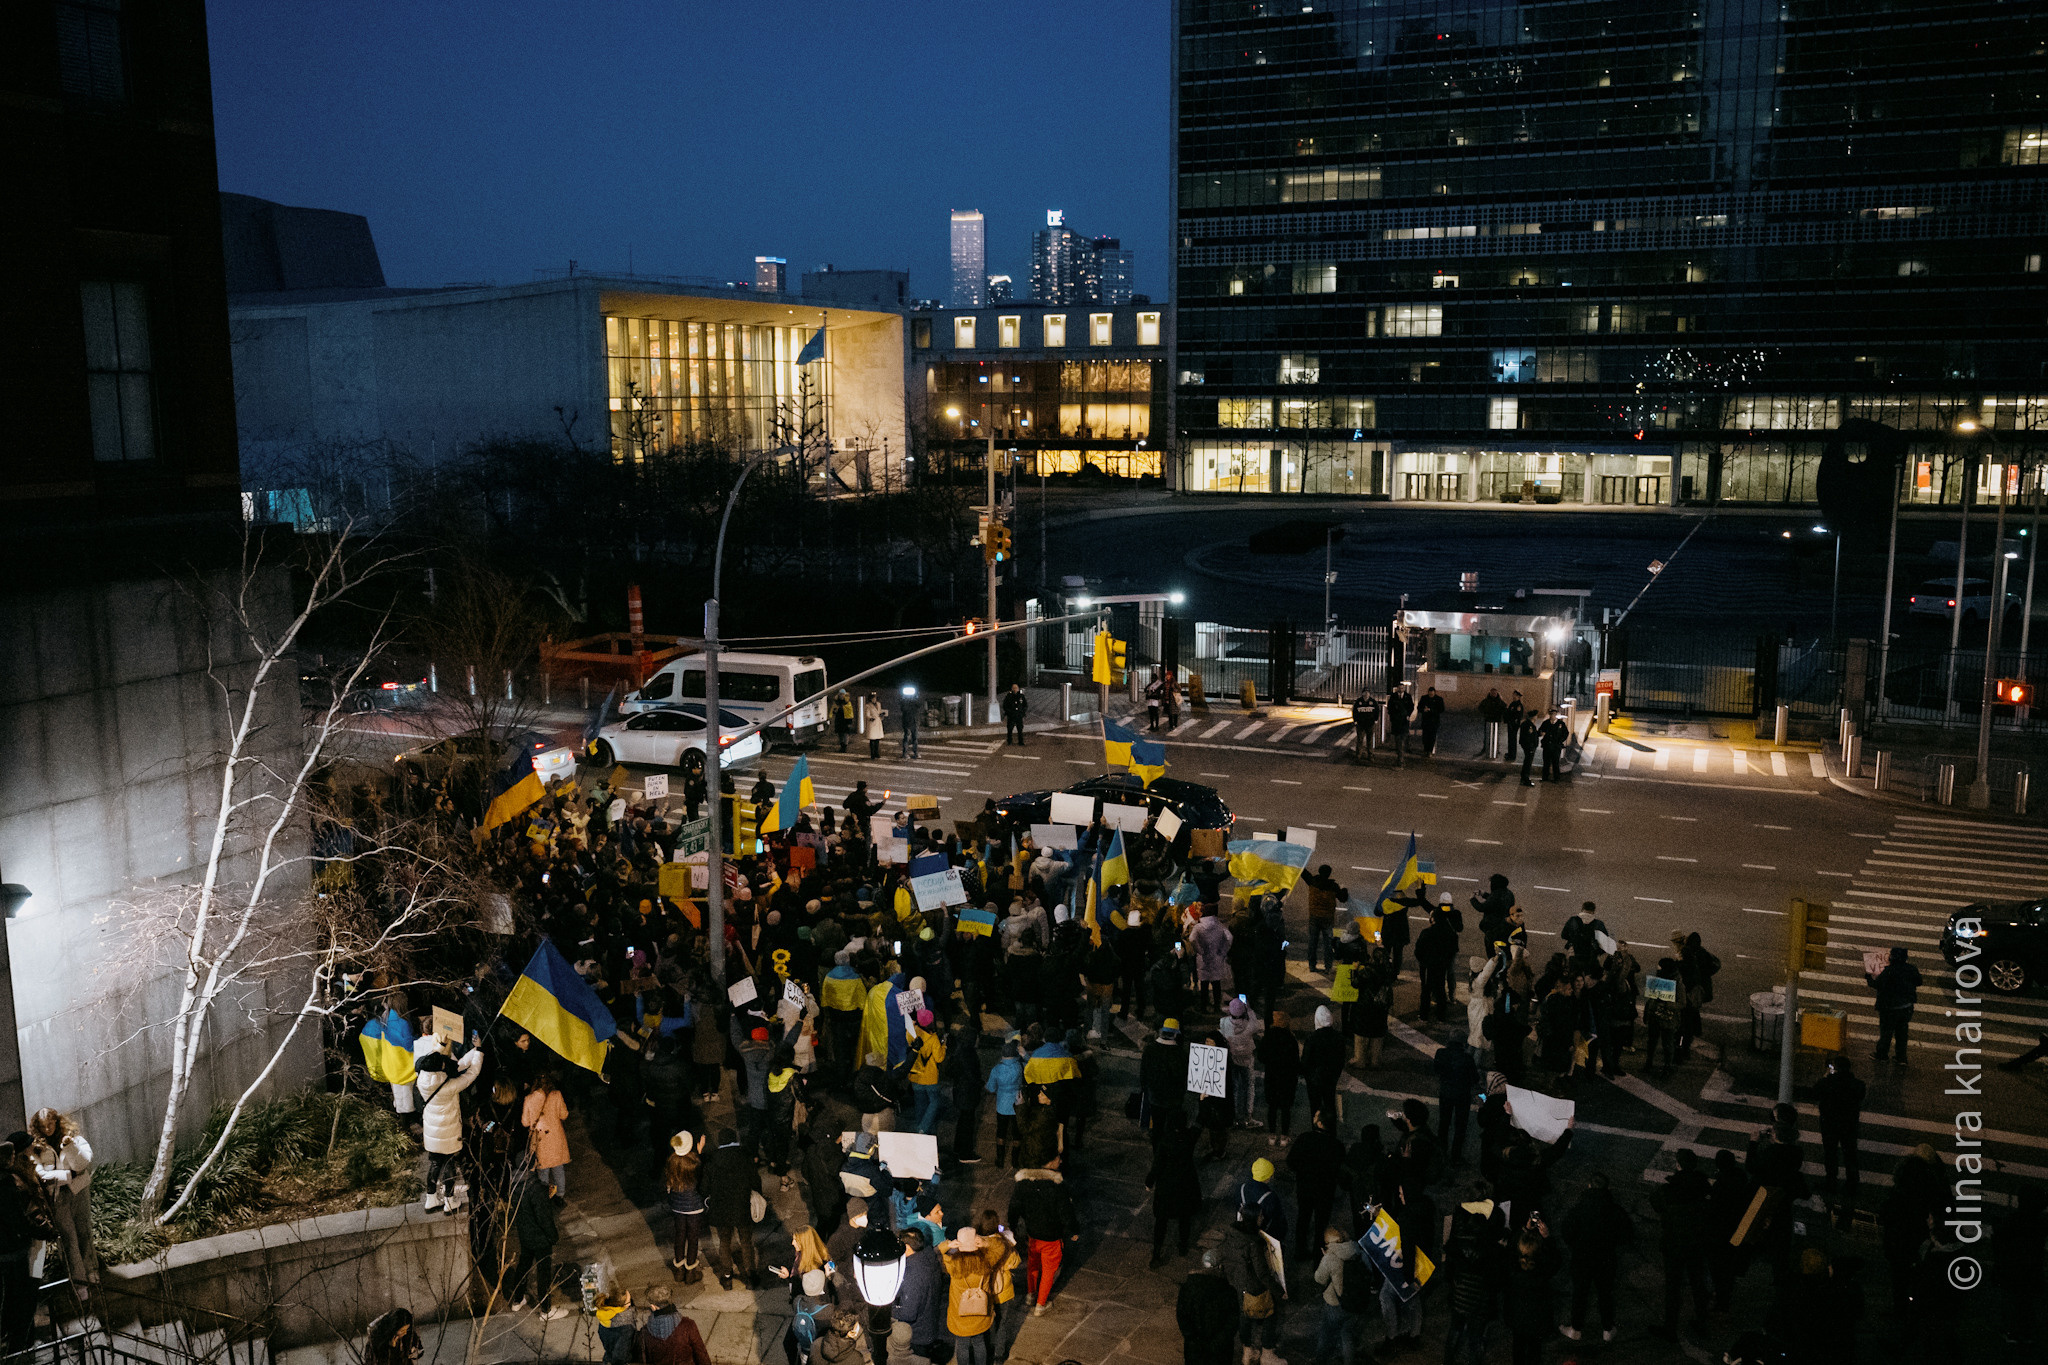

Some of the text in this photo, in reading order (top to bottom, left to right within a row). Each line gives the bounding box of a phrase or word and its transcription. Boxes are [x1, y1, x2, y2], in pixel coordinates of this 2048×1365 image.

[897, 990, 916, 1001] STOP
[1191, 1045, 1224, 1071] STOP
[1190, 1069, 1223, 1095] WAR
